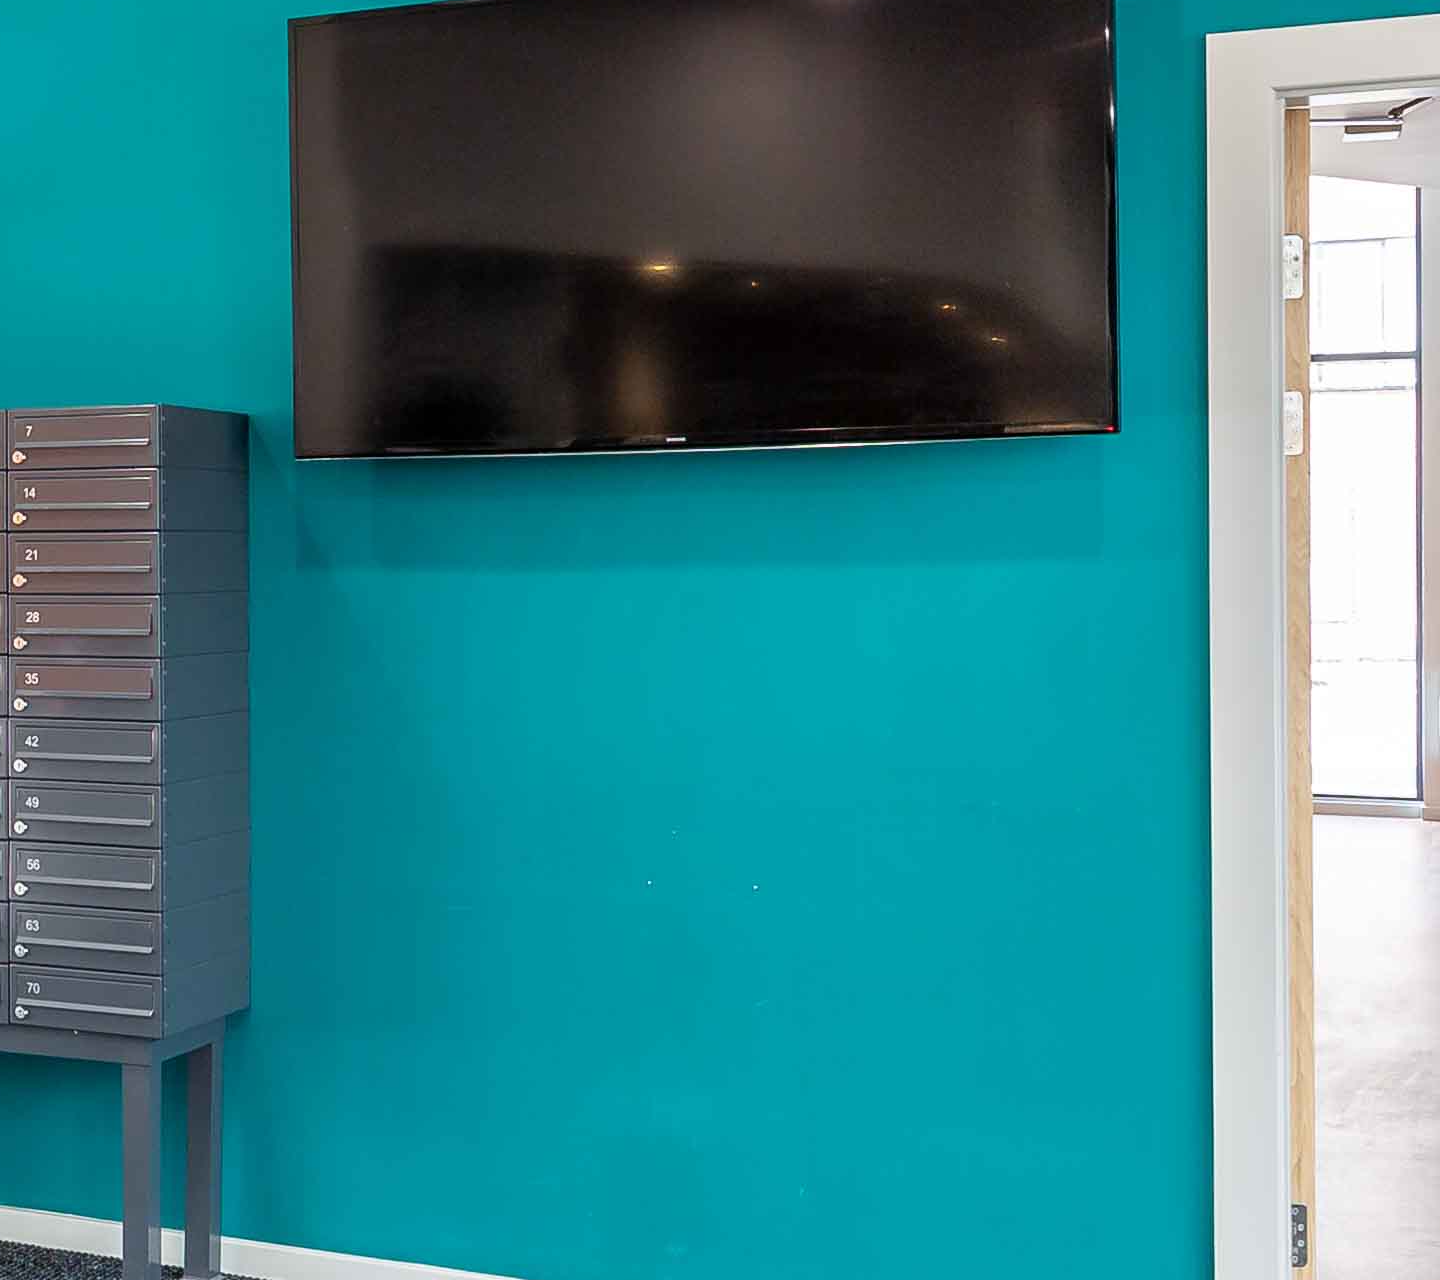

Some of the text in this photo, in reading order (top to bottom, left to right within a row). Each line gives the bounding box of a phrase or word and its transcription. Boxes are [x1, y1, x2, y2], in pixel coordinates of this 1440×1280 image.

[25, 425, 33, 437] 7
[23, 487, 36, 499] 14
[25, 548, 38, 561] 21
[25, 611, 40, 623] 28
[24, 672, 39, 685] 35
[24, 735, 39, 748] 42
[25, 796, 40, 809] 49
[26, 858, 41, 871] 56
[25, 919, 40, 932] 63
[26, 981, 41, 994] 70
